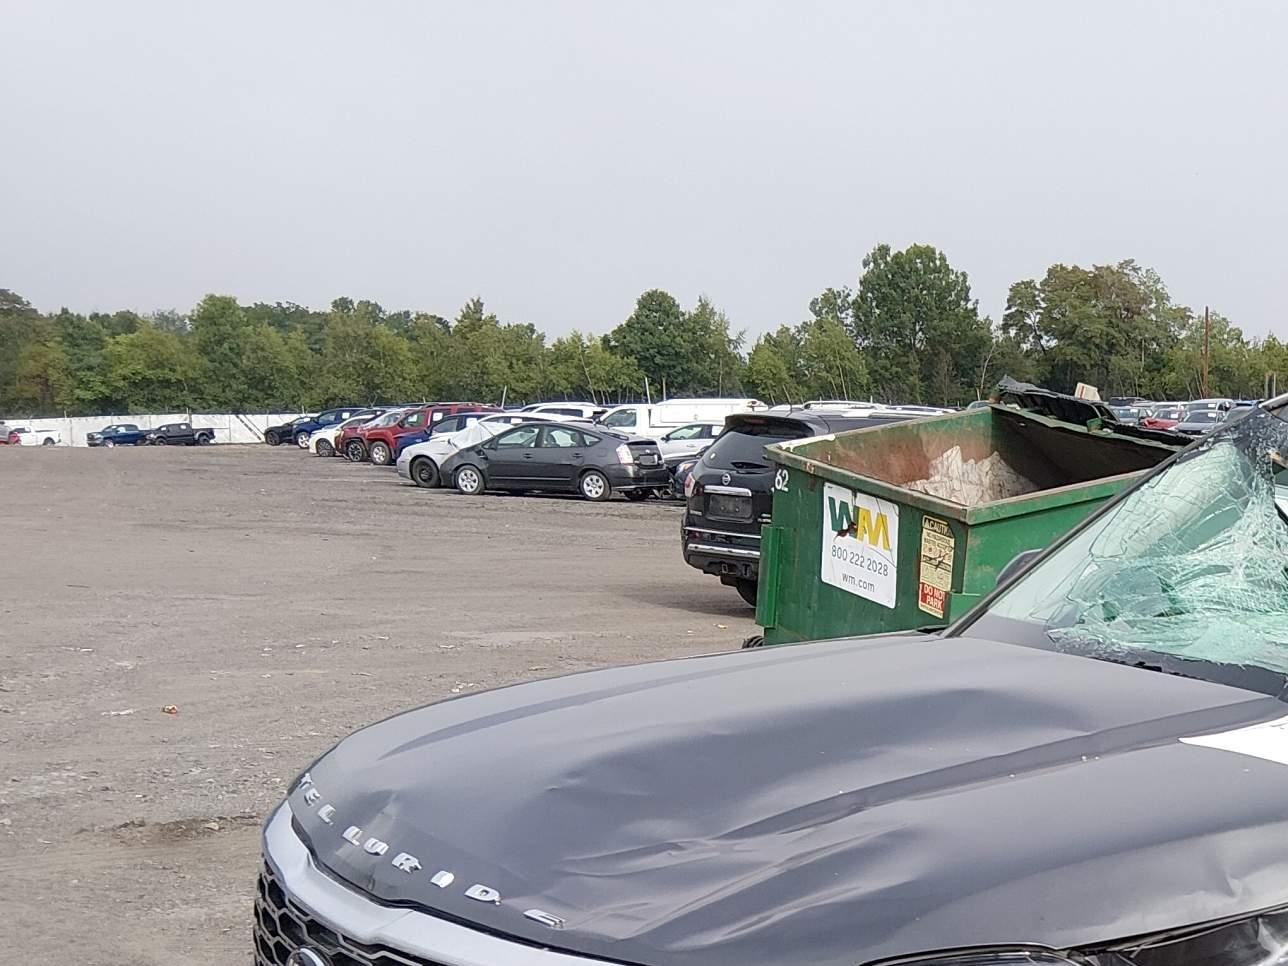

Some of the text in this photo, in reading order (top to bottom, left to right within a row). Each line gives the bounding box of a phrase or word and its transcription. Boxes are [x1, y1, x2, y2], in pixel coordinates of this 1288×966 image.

[775, 468, 789, 492] 62
[828, 496, 891, 552] WM
[831, 545, 889, 577] 800 222 2028
[842, 572, 875, 592] wm.com
[923, 584, 934, 596] DO
[926, 594, 943, 609] PARK
